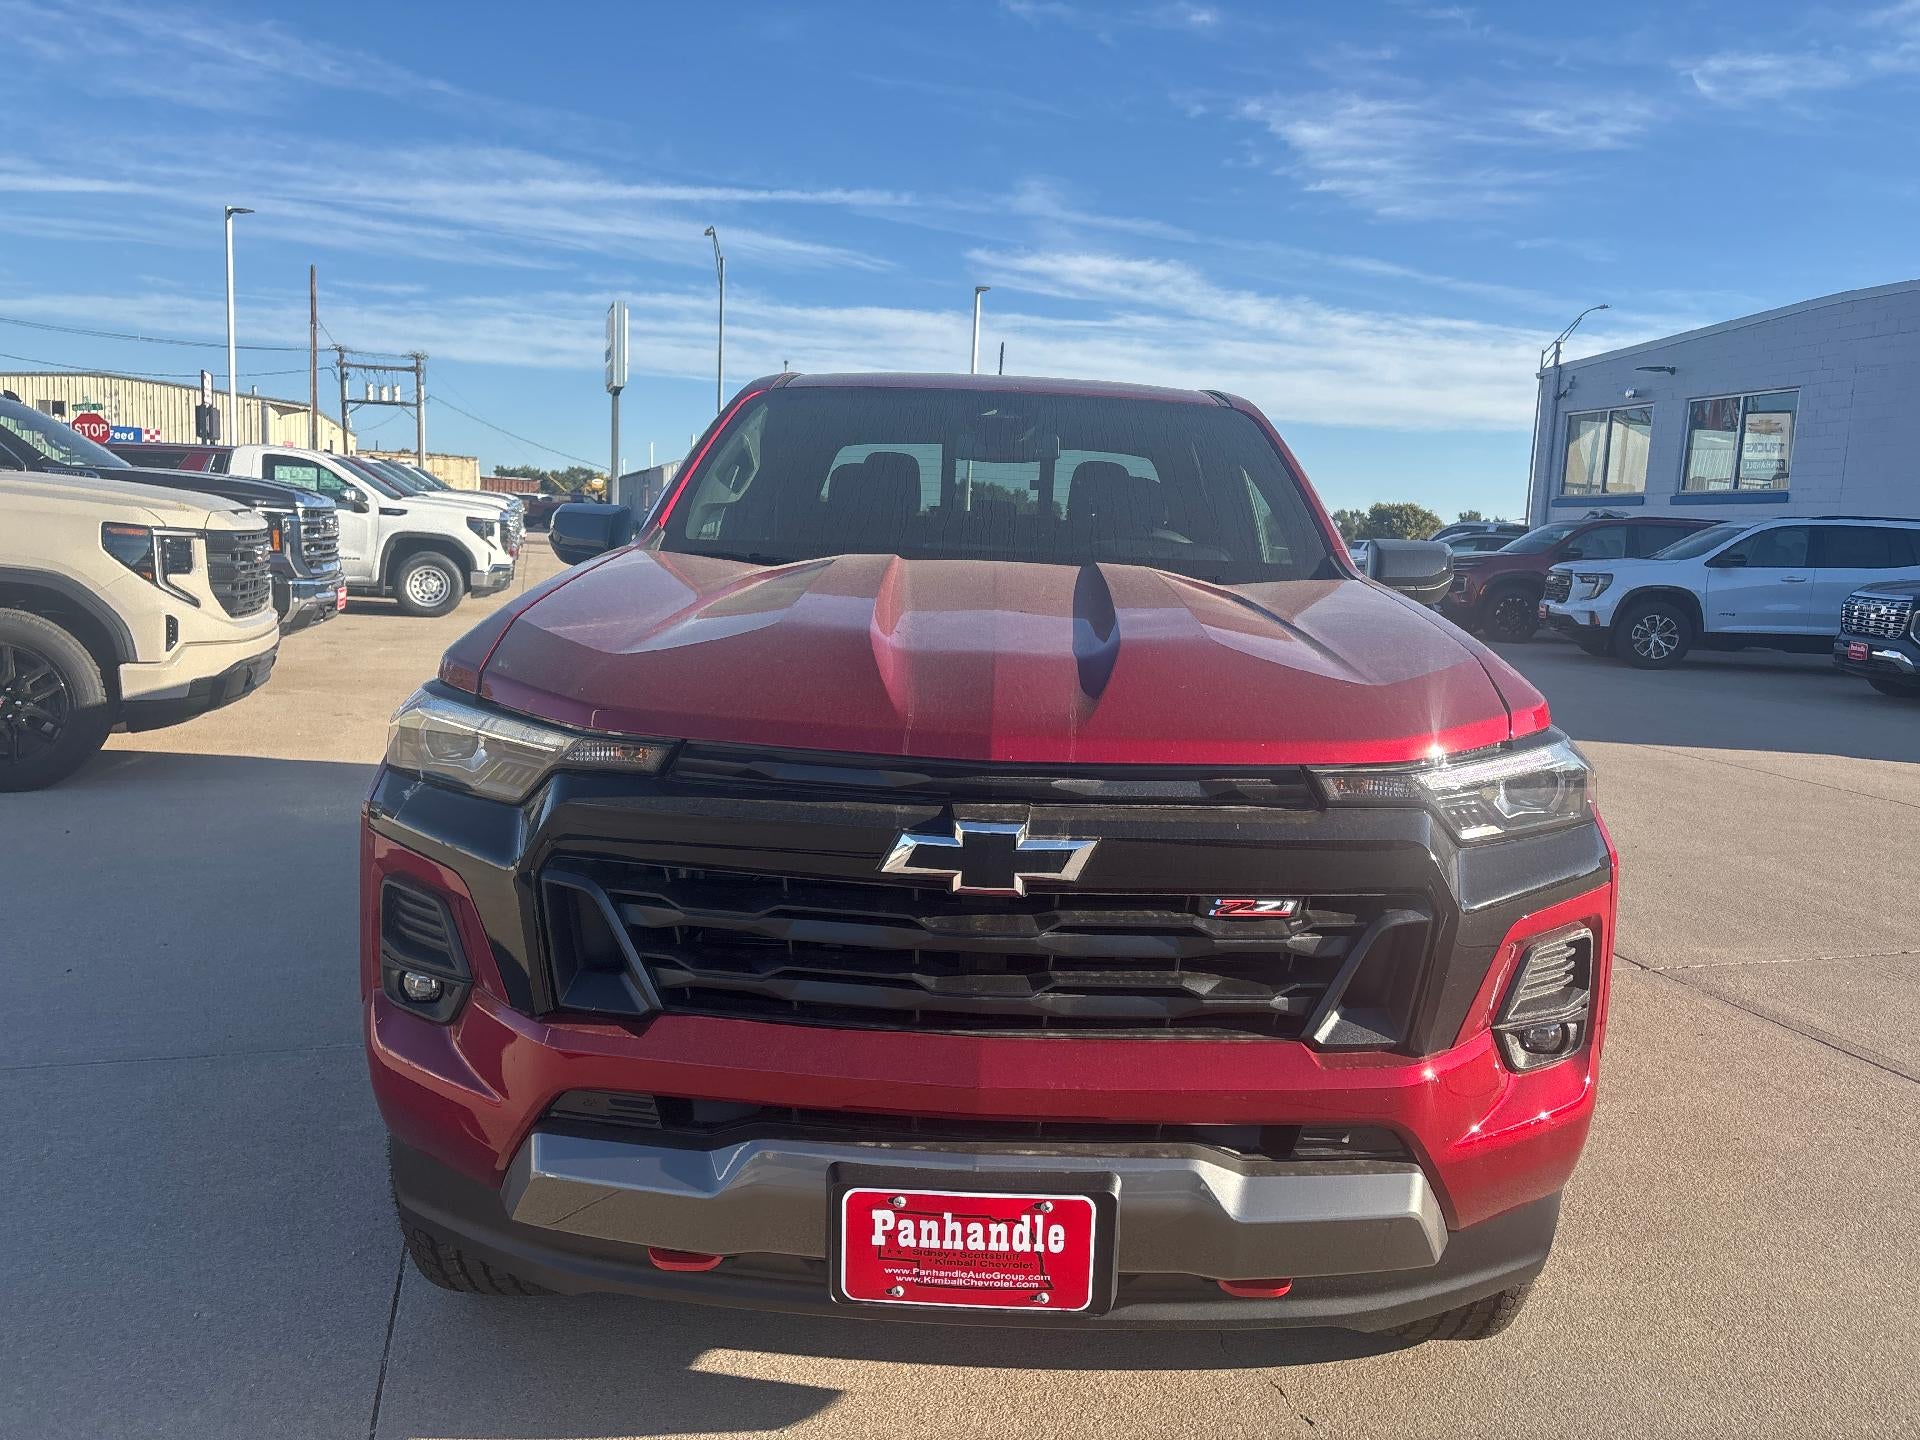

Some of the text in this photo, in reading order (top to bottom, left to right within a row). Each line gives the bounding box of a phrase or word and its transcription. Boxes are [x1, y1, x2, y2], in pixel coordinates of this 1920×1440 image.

[74, 423, 108, 438] STOP
[110, 429, 135, 441] Feed
[1208, 899, 1298, 918] Z71
[871, 1209, 1065, 1254] Panhandle
[912, 1249, 1020, 1260] Sidney Scottsbluff
[980, 1261, 1034, 1269] Chevrolet
[884, 1267, 1051, 1281] www.PanhandleAutoGroup.com
[896, 1275, 1039, 1288] www.KimballChevrolet.com
